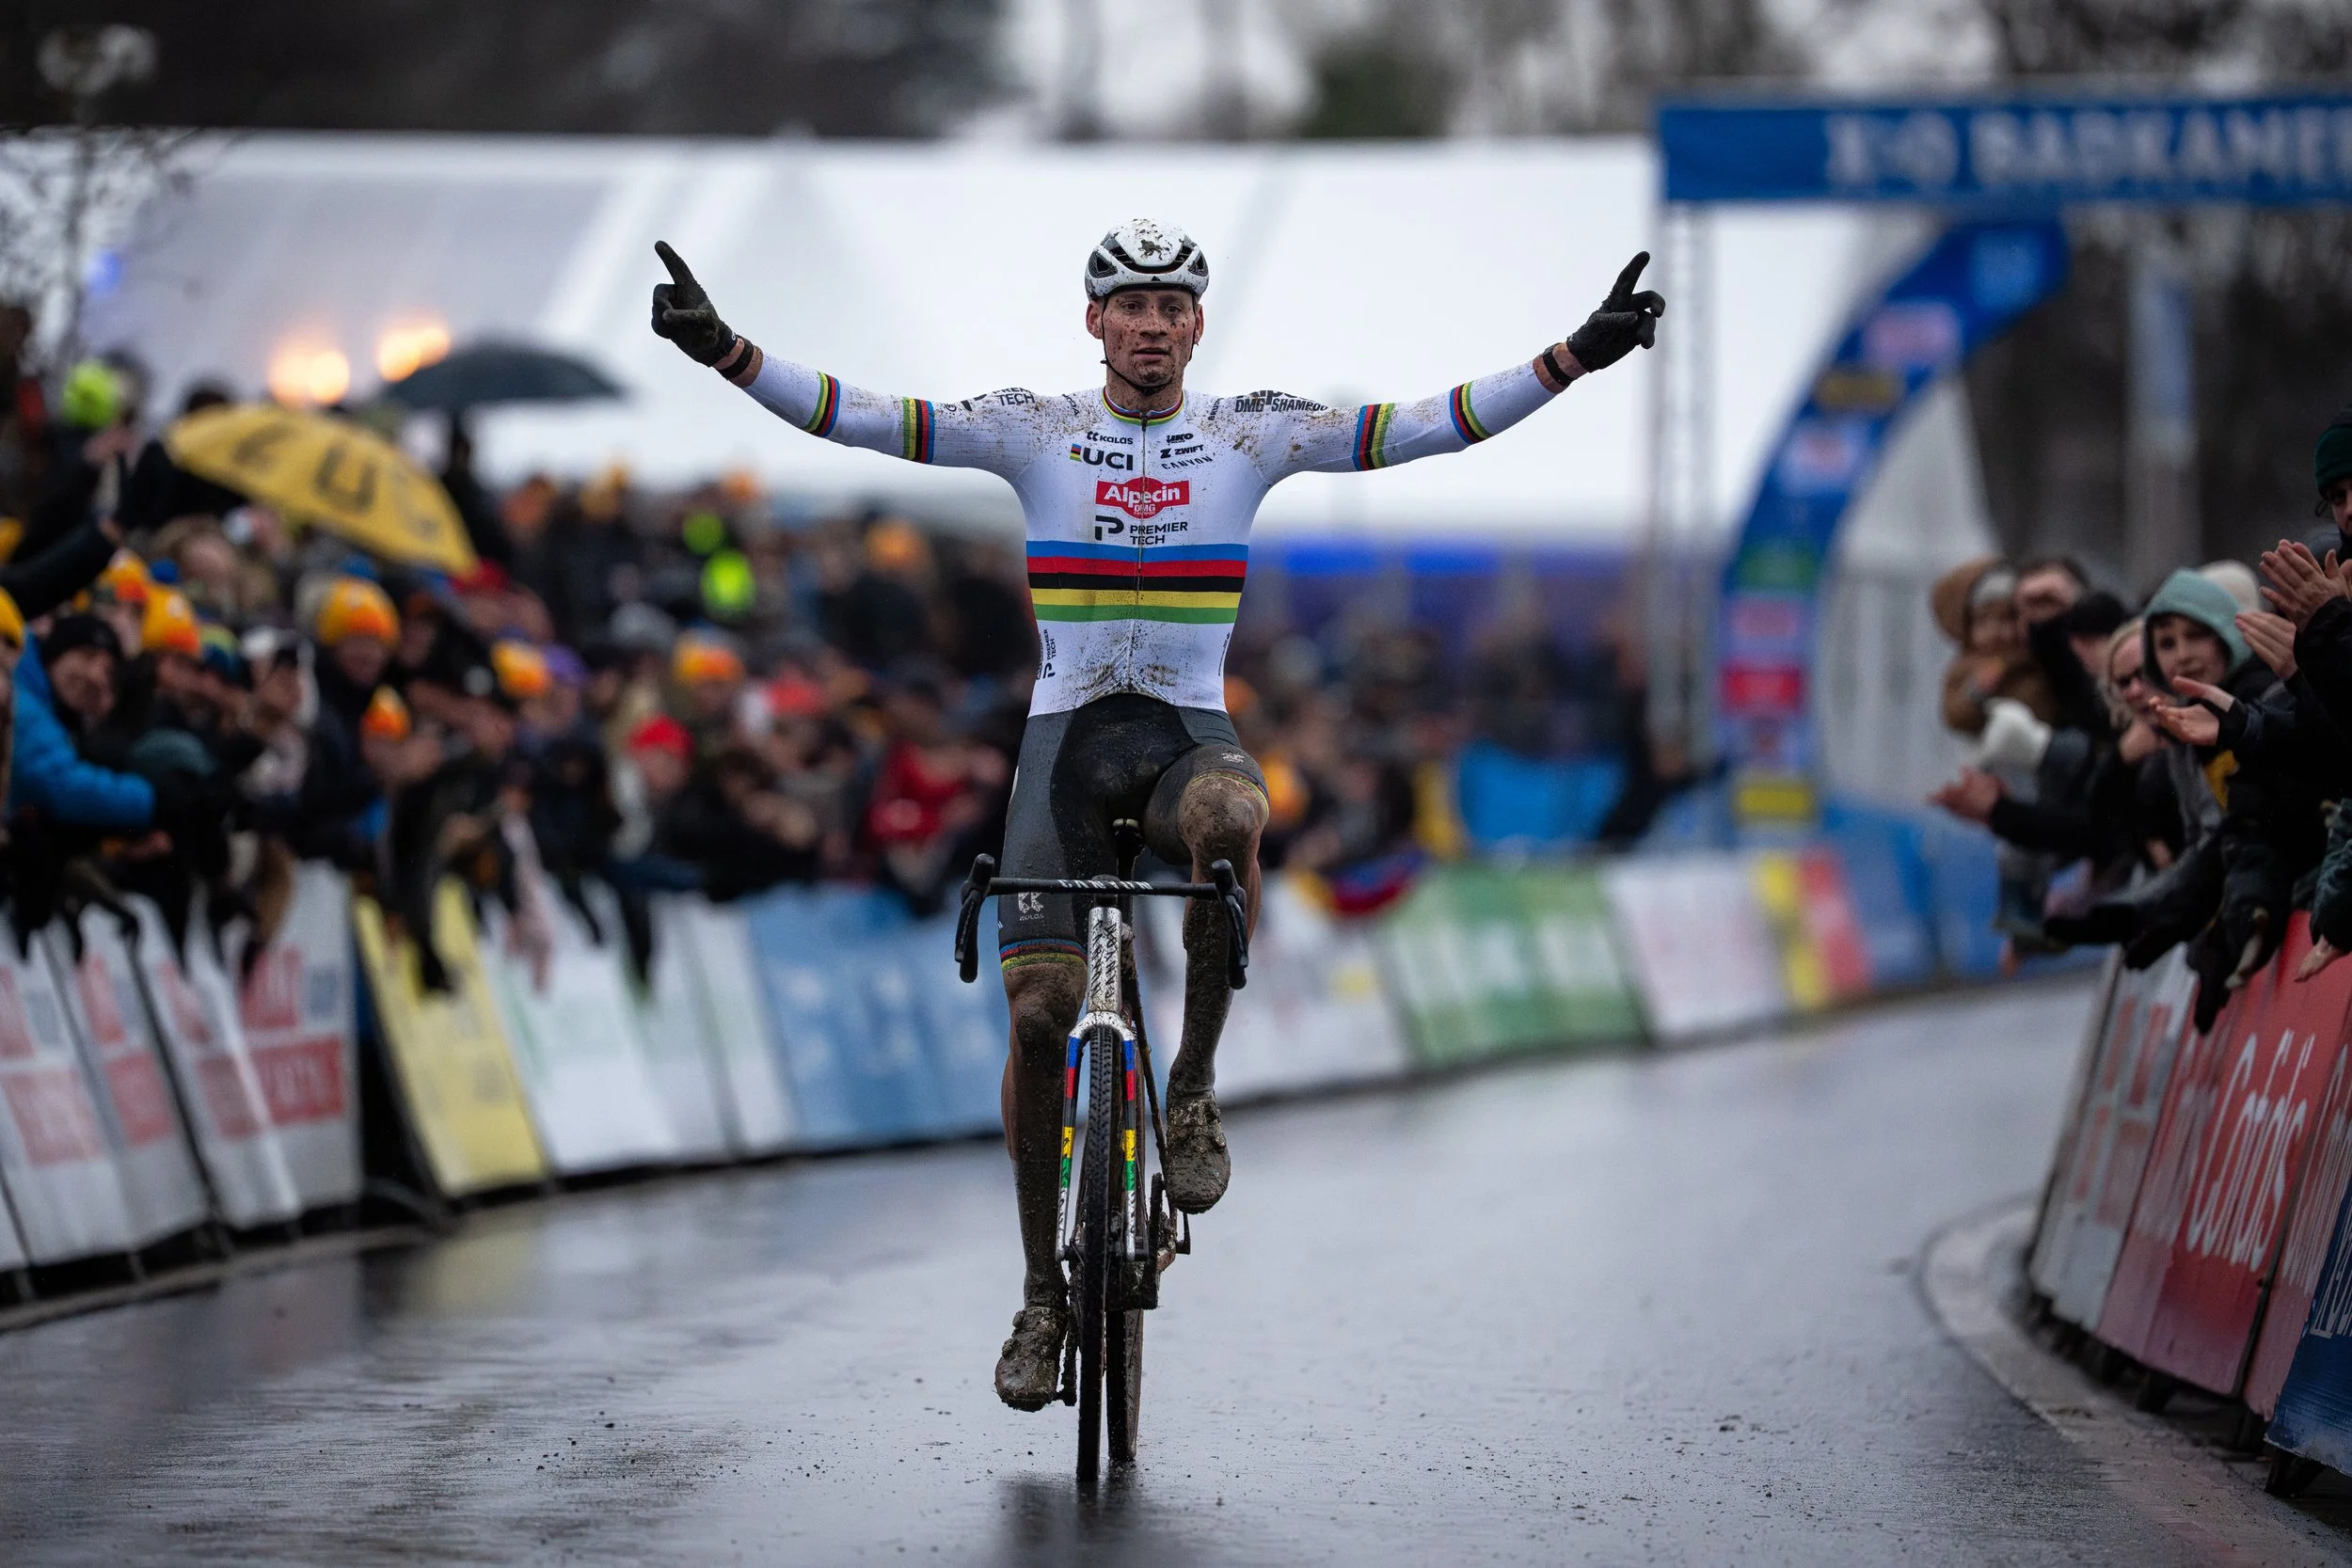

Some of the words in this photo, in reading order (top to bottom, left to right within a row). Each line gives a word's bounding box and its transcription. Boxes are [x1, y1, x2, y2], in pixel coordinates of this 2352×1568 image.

[997, 393, 1035, 406] TECH
[1234, 398, 1265, 413] DMG
[1174, 444, 1204, 455] ZWIFT
[1083, 447, 1134, 470] UCI
[1161, 455, 1214, 470] CANYON
[1104, 484, 1181, 508] Alpecin
[1129, 521, 1188, 535] PREMIER
[1129, 534, 1166, 546] TECH
[2184, 1026, 2316, 1273] Cofidis
